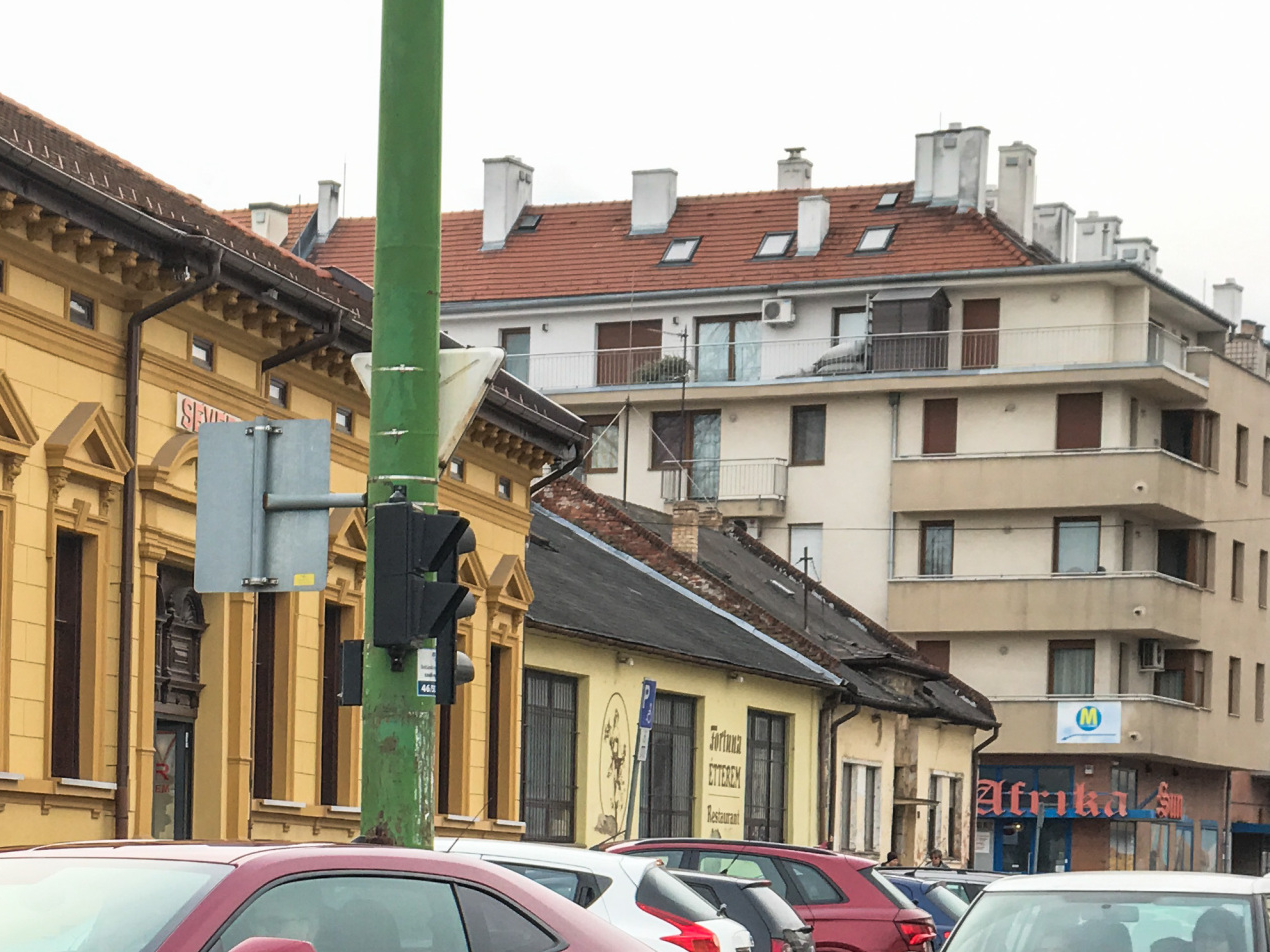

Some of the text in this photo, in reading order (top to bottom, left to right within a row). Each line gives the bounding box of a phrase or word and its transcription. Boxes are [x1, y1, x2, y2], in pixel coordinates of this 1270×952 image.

[642, 684, 651, 709] P
[1080, 707, 1097, 725] M
[709, 725, 742, 754] Fortuna
[977, 778, 1128, 817] Afrika
[707, 804, 739, 825] Restaurant
